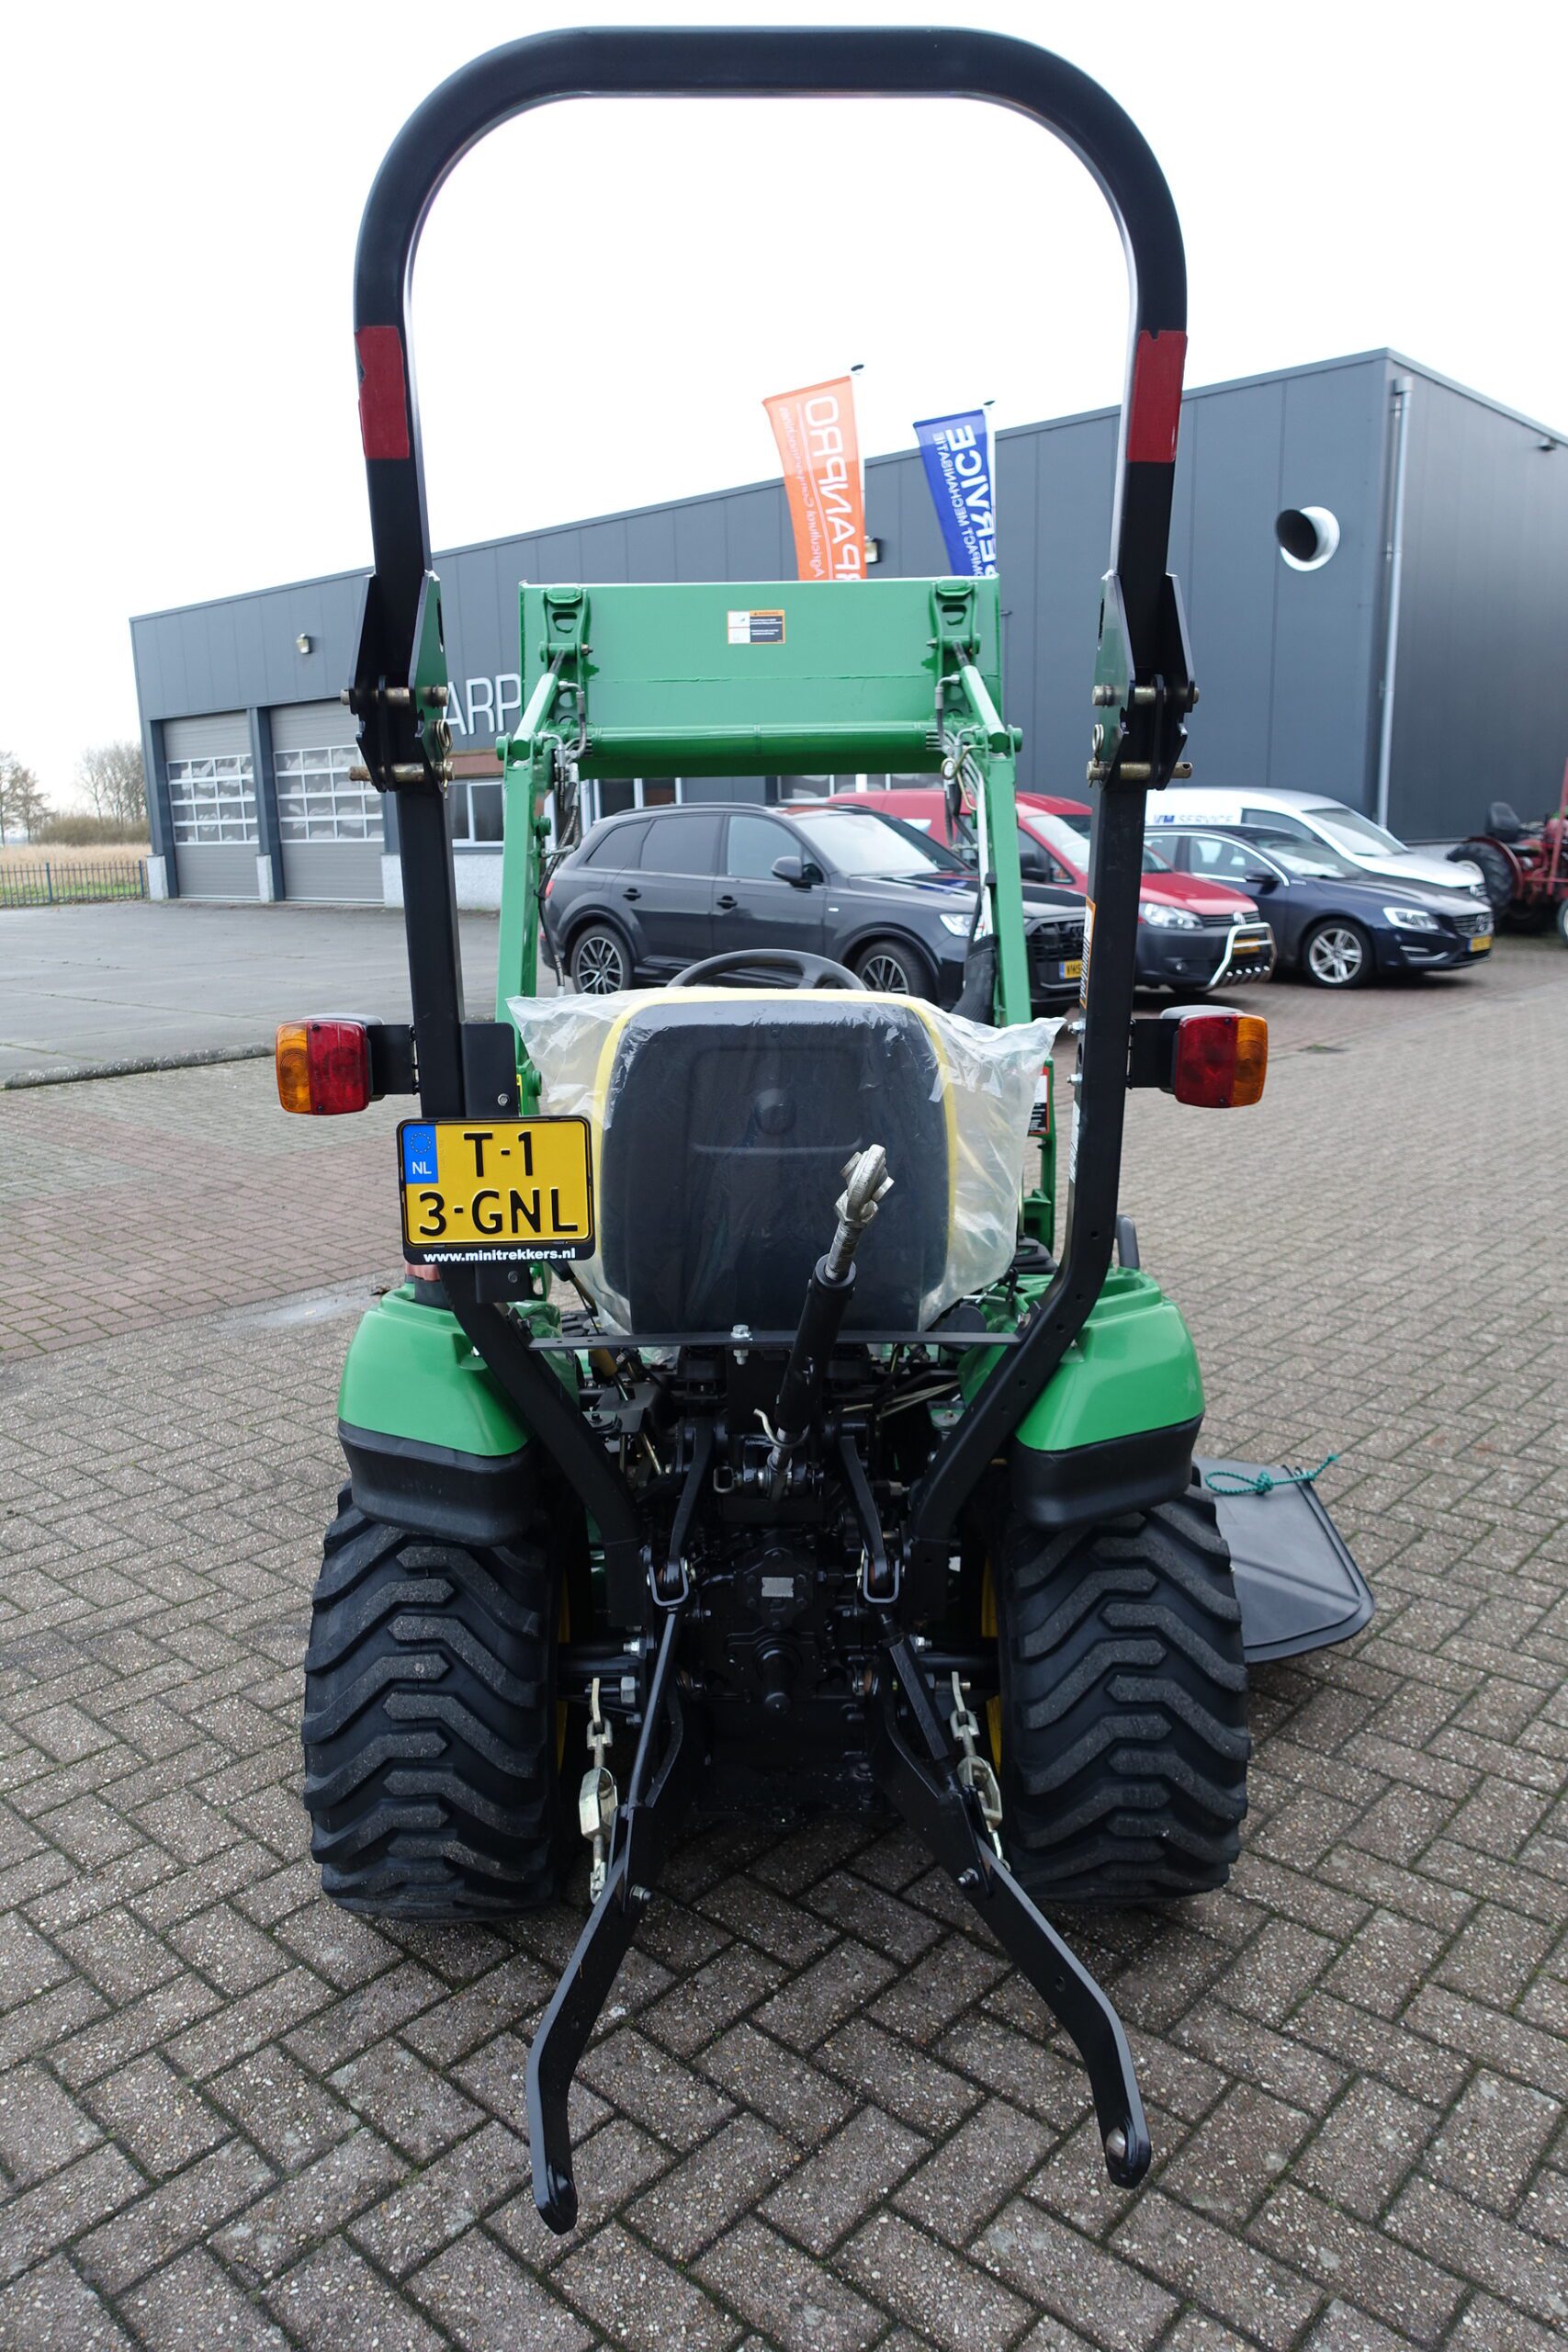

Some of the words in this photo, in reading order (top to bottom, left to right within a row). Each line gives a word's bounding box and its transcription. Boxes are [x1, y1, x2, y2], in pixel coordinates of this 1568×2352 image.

[412, 1161, 432, 1175] NL
[463, 1131, 534, 1178] T-1
[419, 1188, 578, 1237] 3-GNL
[423, 1248, 576, 1262] www.minitrekkers.nl
